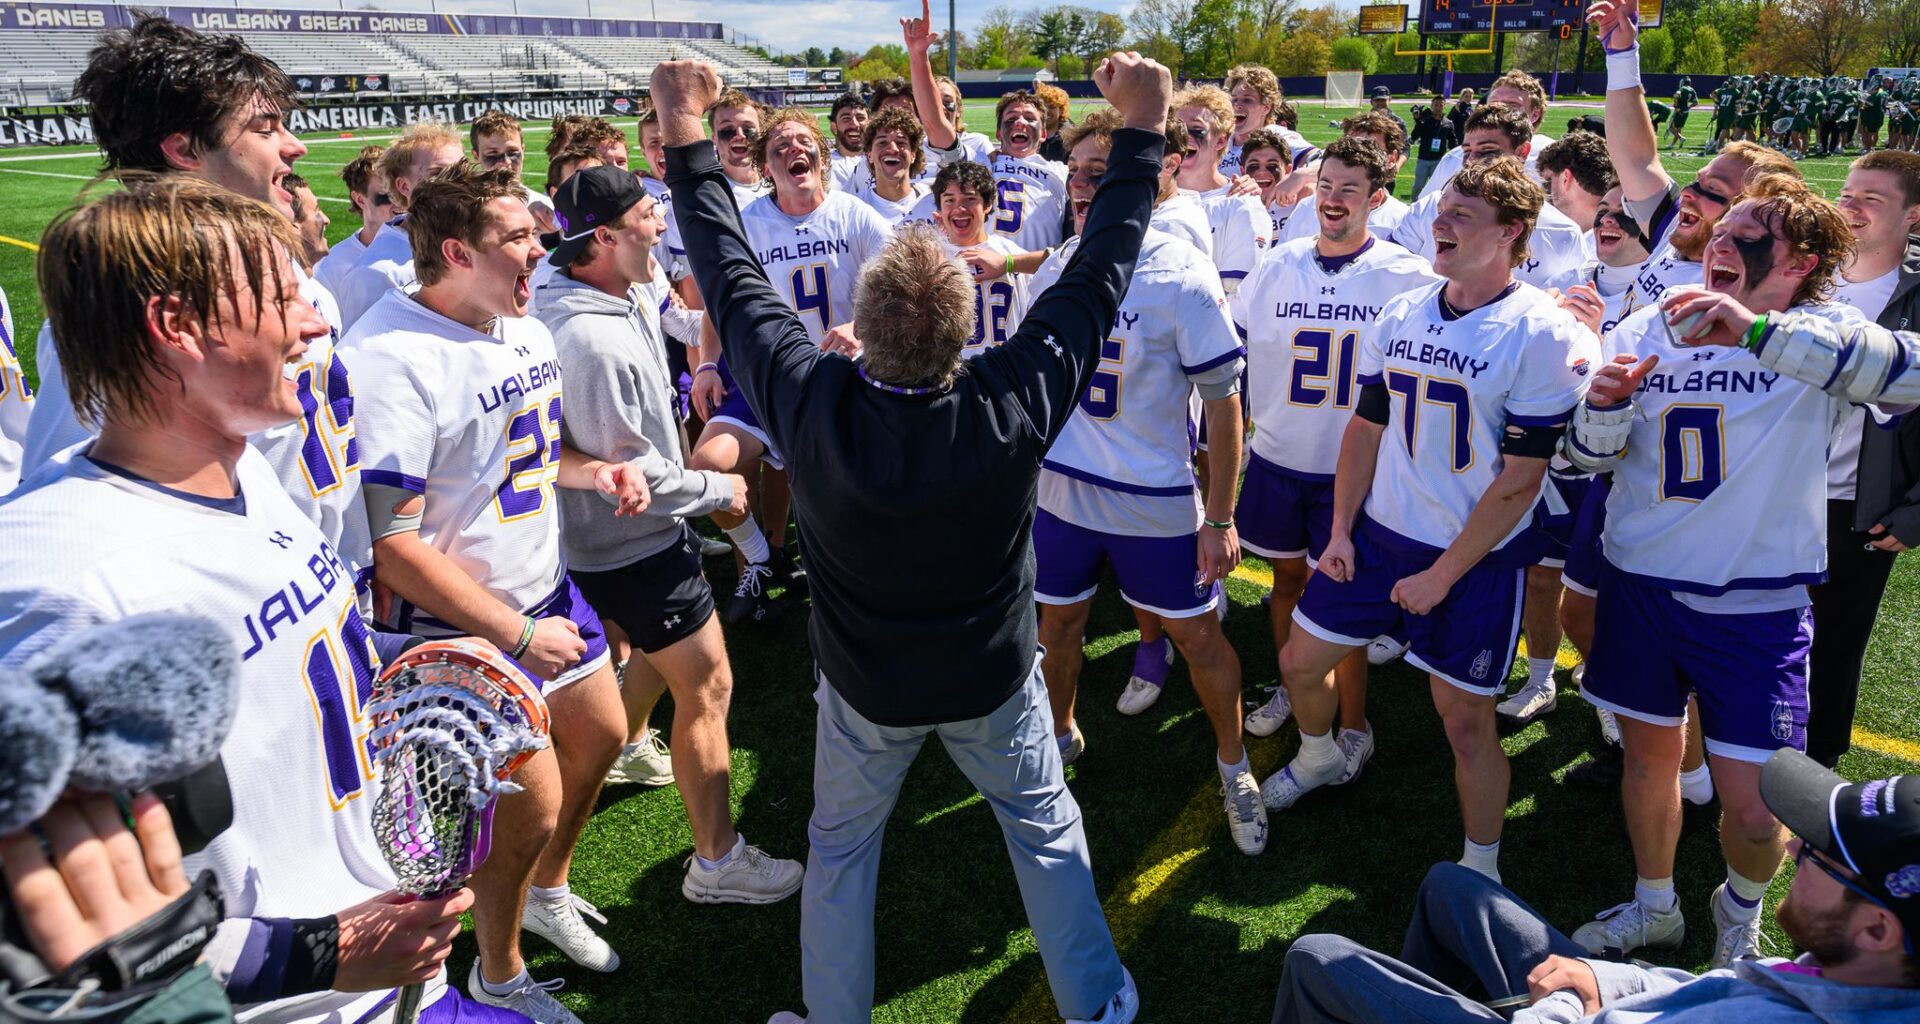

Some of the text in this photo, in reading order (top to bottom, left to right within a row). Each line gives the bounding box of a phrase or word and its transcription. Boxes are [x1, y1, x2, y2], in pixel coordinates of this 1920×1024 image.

[16, 8, 105, 27] DANES
[192, 12, 428, 33] UALBANY GREAT DANES
[289, 106, 398, 131] AMERICA
[404, 102, 456, 125] EAST
[463, 98, 606, 121] CHAMPIONSHIP
[1720, 94, 1733, 106] 27
[993, 177, 1026, 236] 5
[759, 239, 849, 266] UALBANY
[789, 262, 833, 336] 4
[1276, 302, 1382, 321] UALBANY
[1287, 327, 1359, 410] 21
[1386, 367, 1475, 474] 77
[1658, 402, 1728, 505] 0
